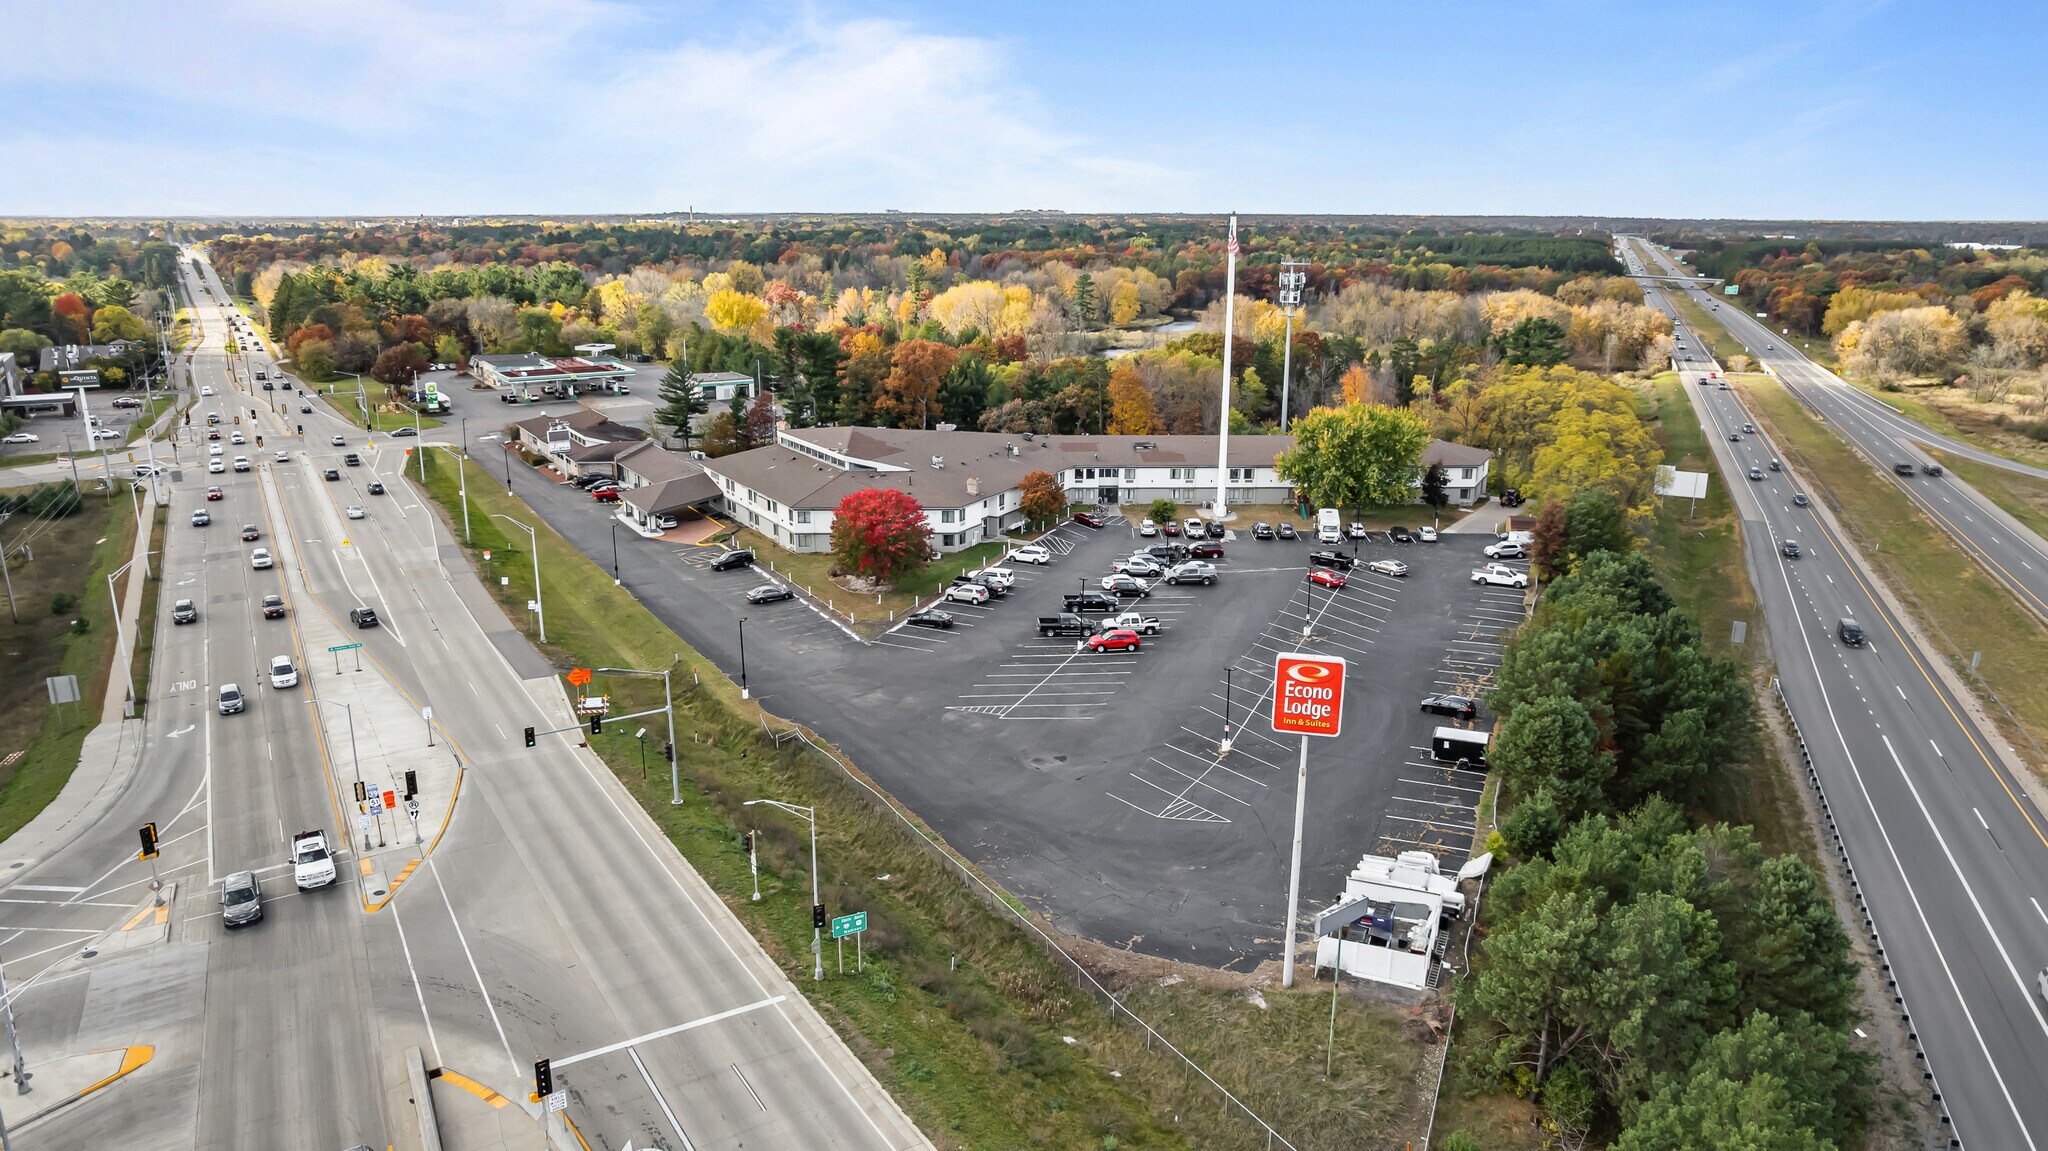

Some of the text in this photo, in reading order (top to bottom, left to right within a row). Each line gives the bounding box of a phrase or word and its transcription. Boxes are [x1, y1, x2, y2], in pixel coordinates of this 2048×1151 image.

[170, 679, 197, 693] ONLY
[1285, 680, 1333, 700] Econo
[1283, 697, 1331, 719] Lodge
[1283, 717, 1331, 728] Inn & Suites
